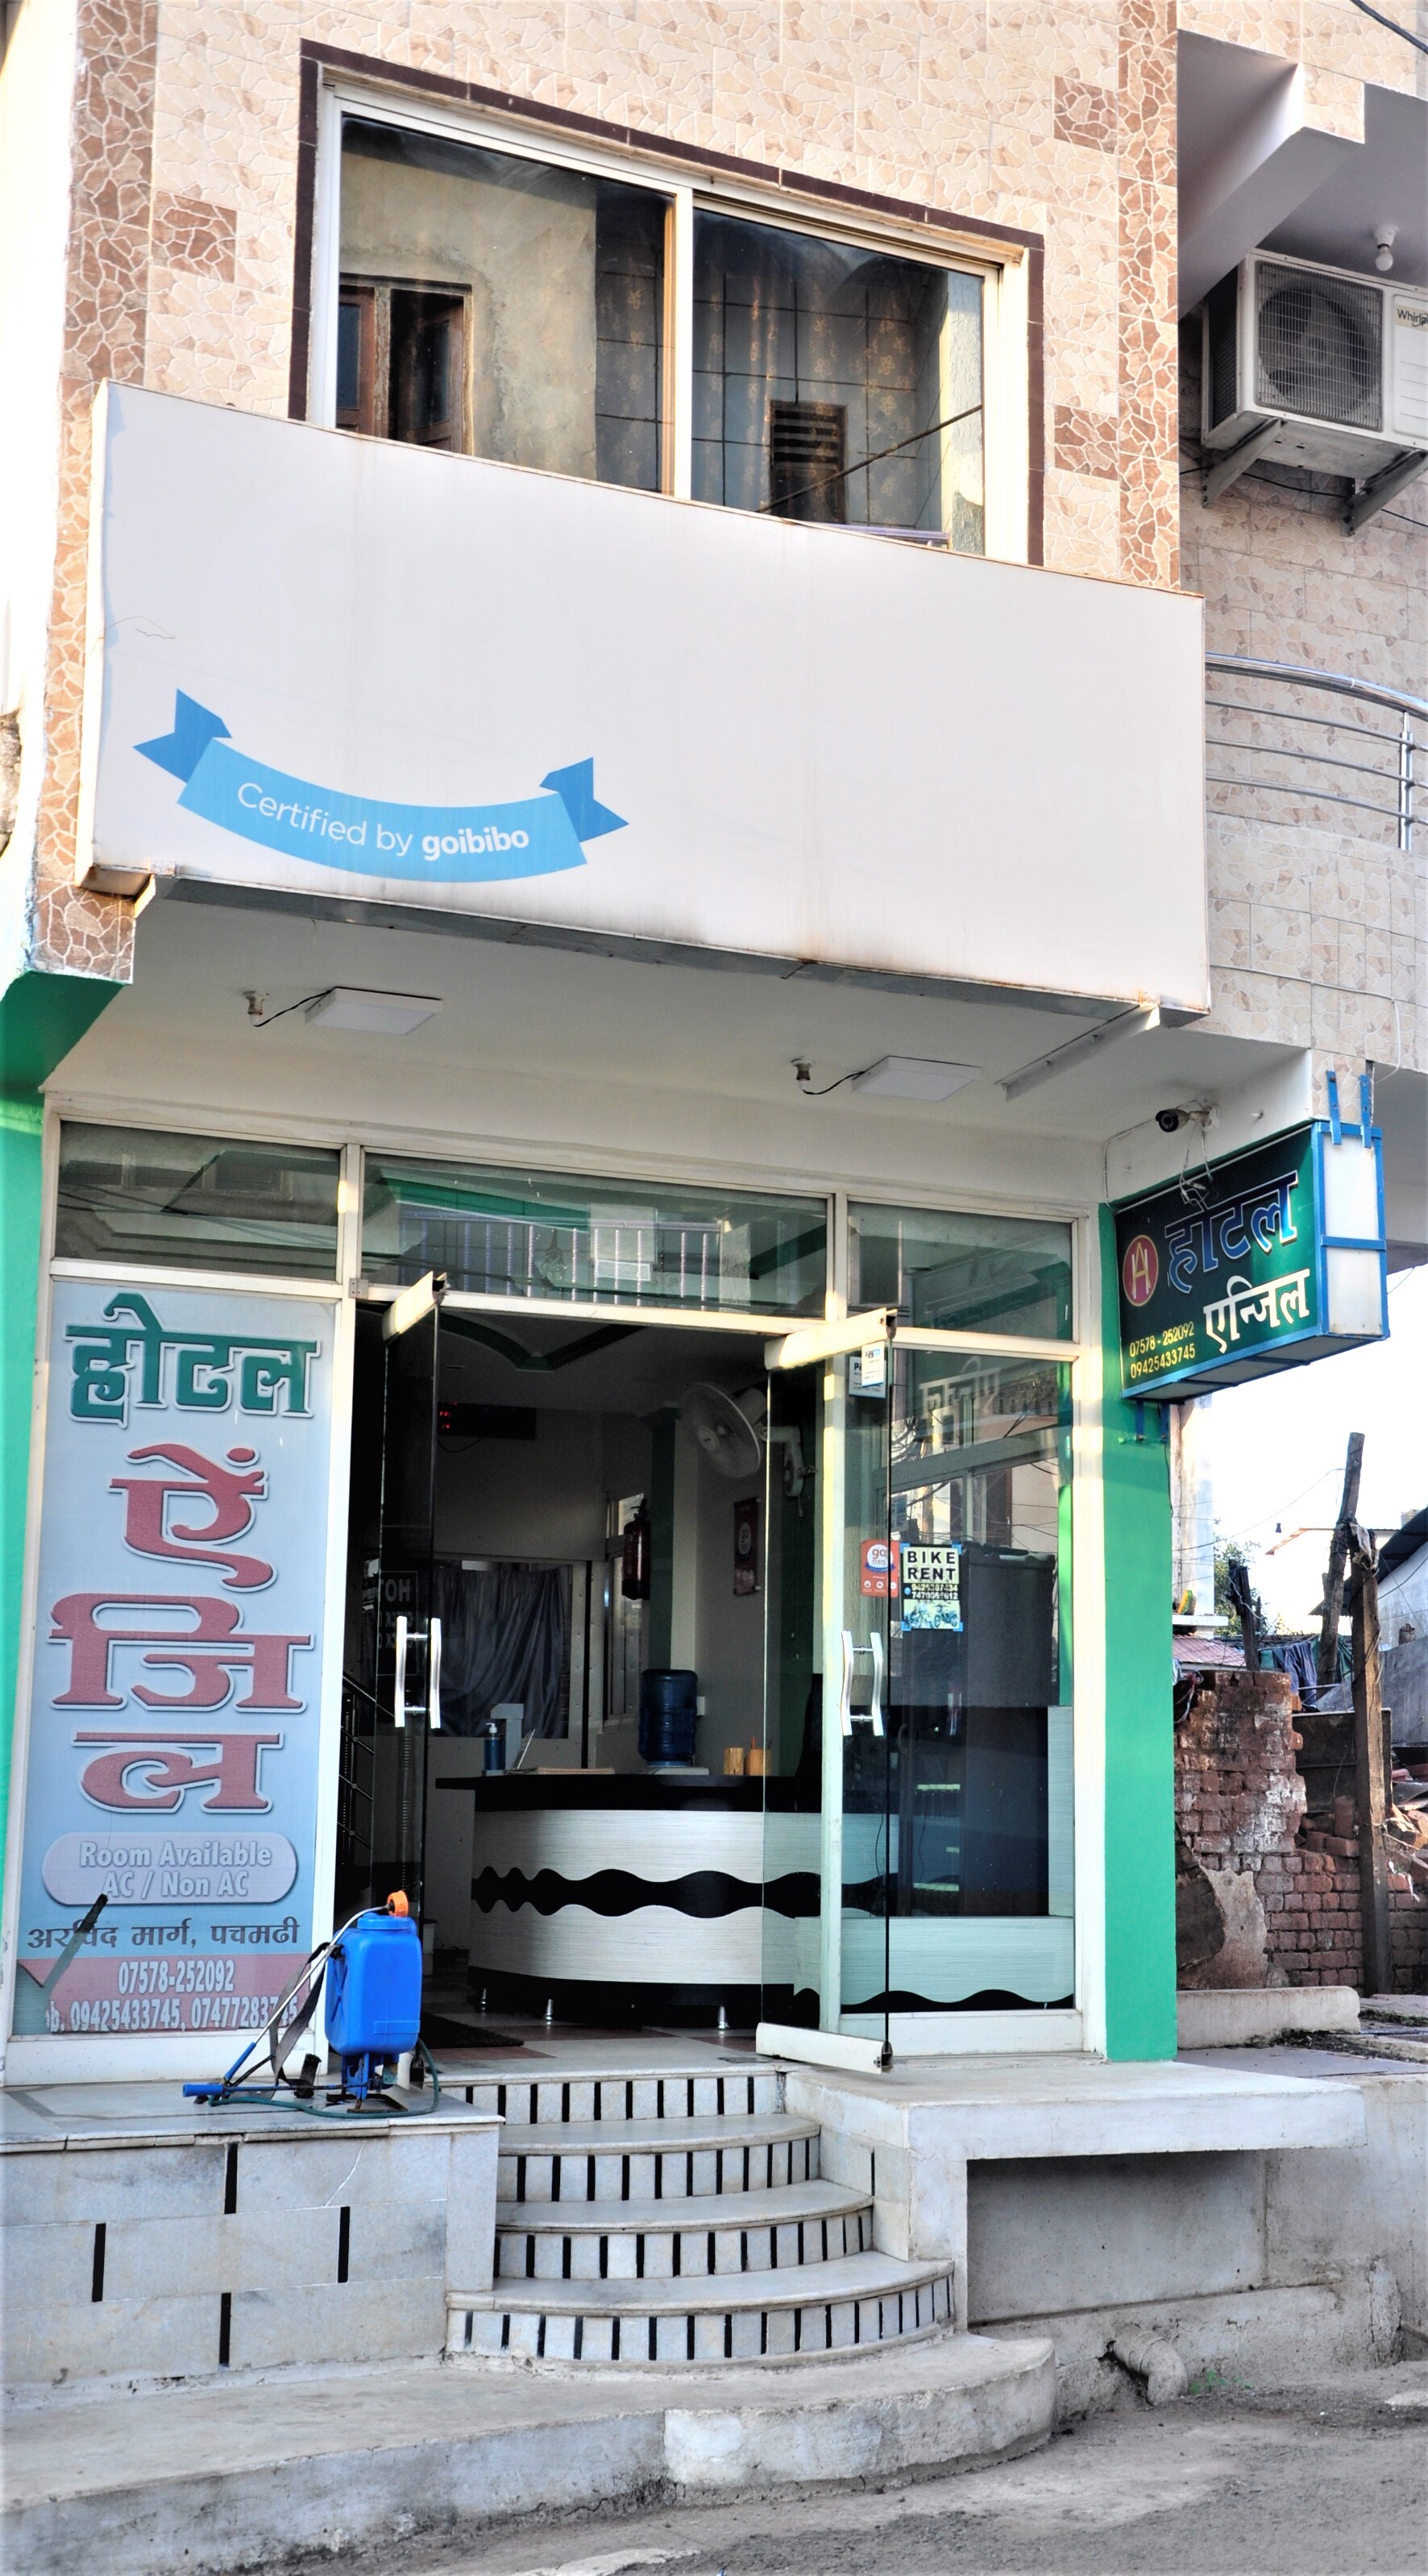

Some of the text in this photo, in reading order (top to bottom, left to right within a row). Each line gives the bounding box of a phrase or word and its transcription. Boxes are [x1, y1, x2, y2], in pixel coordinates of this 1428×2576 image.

[238, 781, 530, 861] Certified by goibibo
[1164, 1170, 1299, 1294] होटल
[1203, 1269, 1310, 1354] एन्जिल
[1129, 1335, 1156, 1357] 07578
[1163, 1321, 1194, 1346] 252092
[64, 1292, 321, 1428] होटल
[1130, 1343, 1196, 1378] 09425433745
[907, 1551, 956, 1564] BIKE
[908, 1567, 956, 1580] RENT
[80, 1841, 272, 1868] Room Available
[101, 1871, 134, 1898] AC
[161, 1872, 210, 1897] Non
[217, 1871, 248, 1897] AC
[211, 1916, 300, 1945] पचमढी
[118, 1959, 235, 1995] 07578-252092
